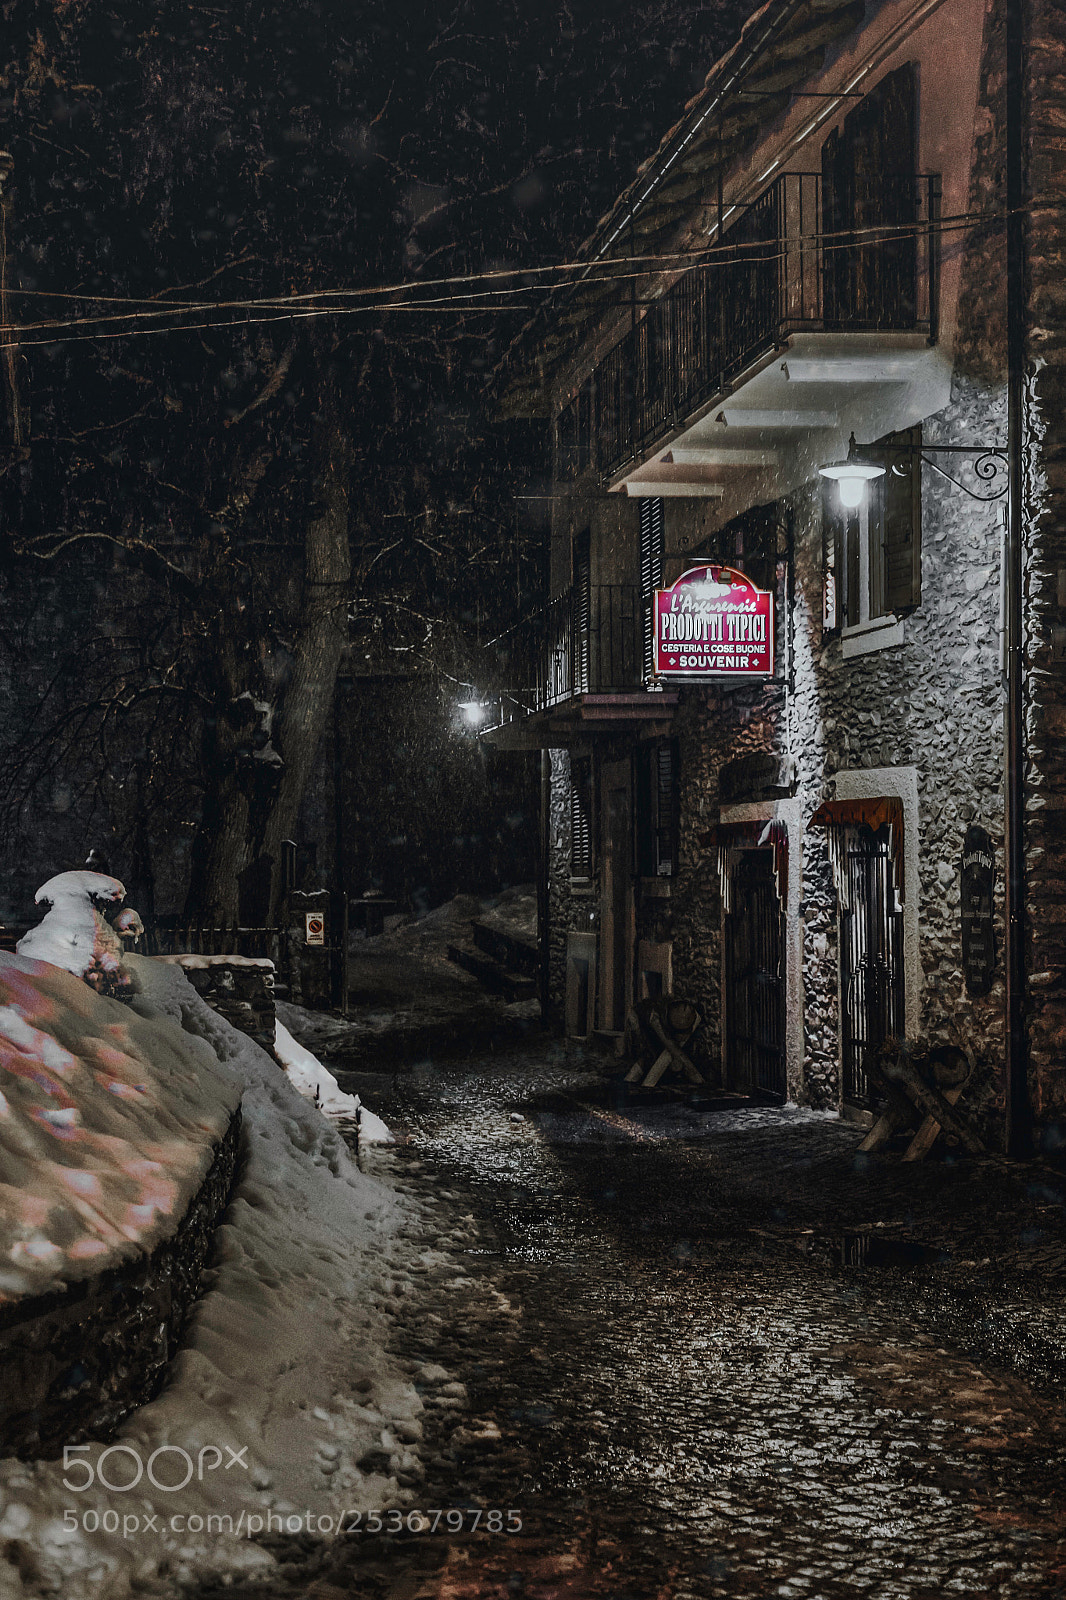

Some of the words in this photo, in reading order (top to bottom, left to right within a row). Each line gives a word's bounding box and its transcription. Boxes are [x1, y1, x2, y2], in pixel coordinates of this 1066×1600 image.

[661, 613, 723, 641] PRODOTTI
[726, 614, 766, 642] TIPICI
[661, 644, 702, 653] CESTERIA
[703, 644, 710, 653] E
[711, 644, 734, 653] COSE
[736, 644, 766, 654] BUONE
[679, 655, 749, 668] SOUVENIR
